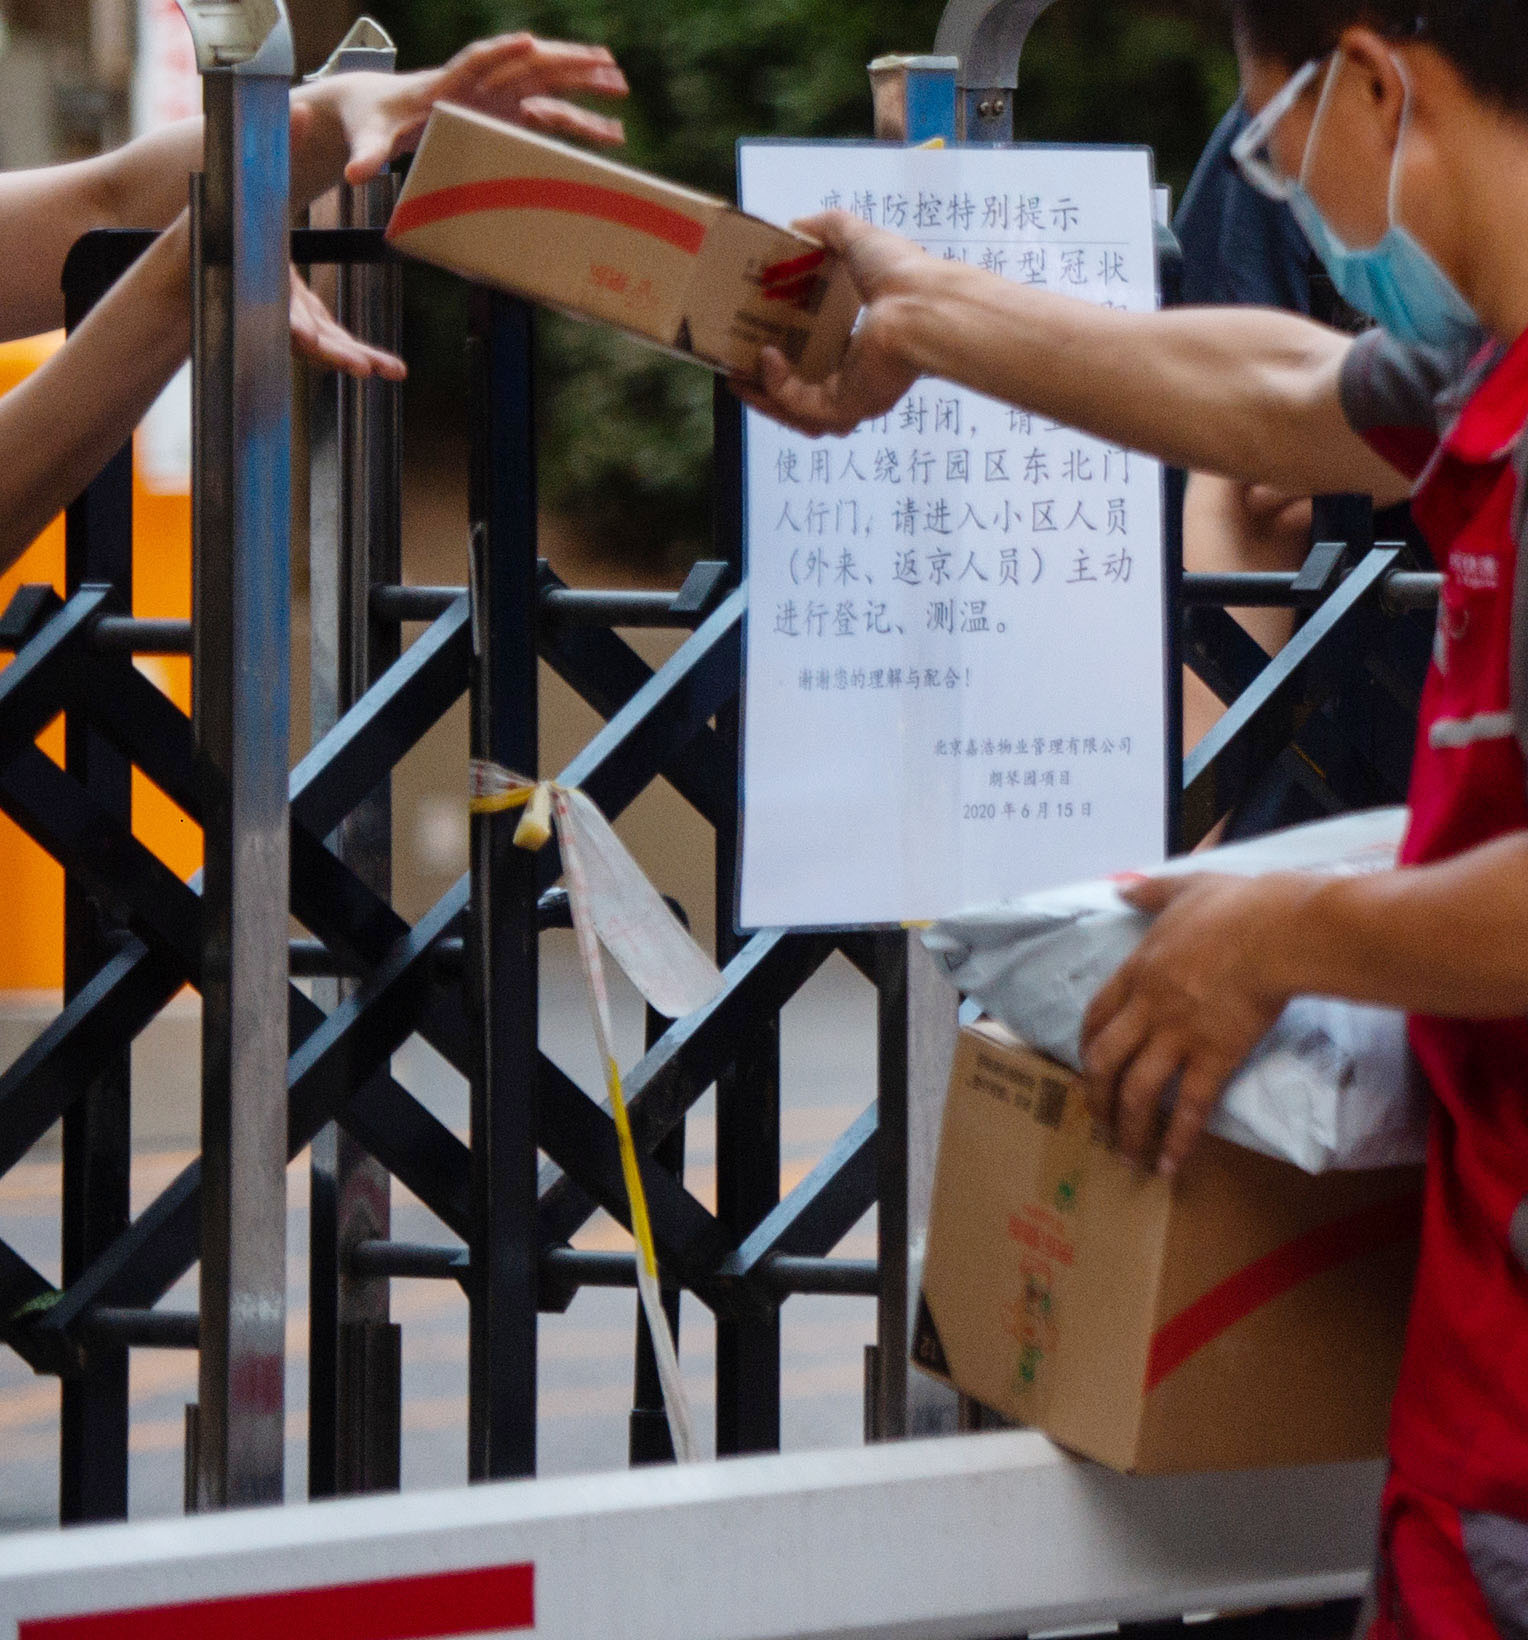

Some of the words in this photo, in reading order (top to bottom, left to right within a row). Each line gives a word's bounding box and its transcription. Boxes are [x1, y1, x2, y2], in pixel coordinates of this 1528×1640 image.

[774, 446, 1130, 485] 使用人绕行园区东北门
[773, 598, 1007, 637] 进行登记、测温。
